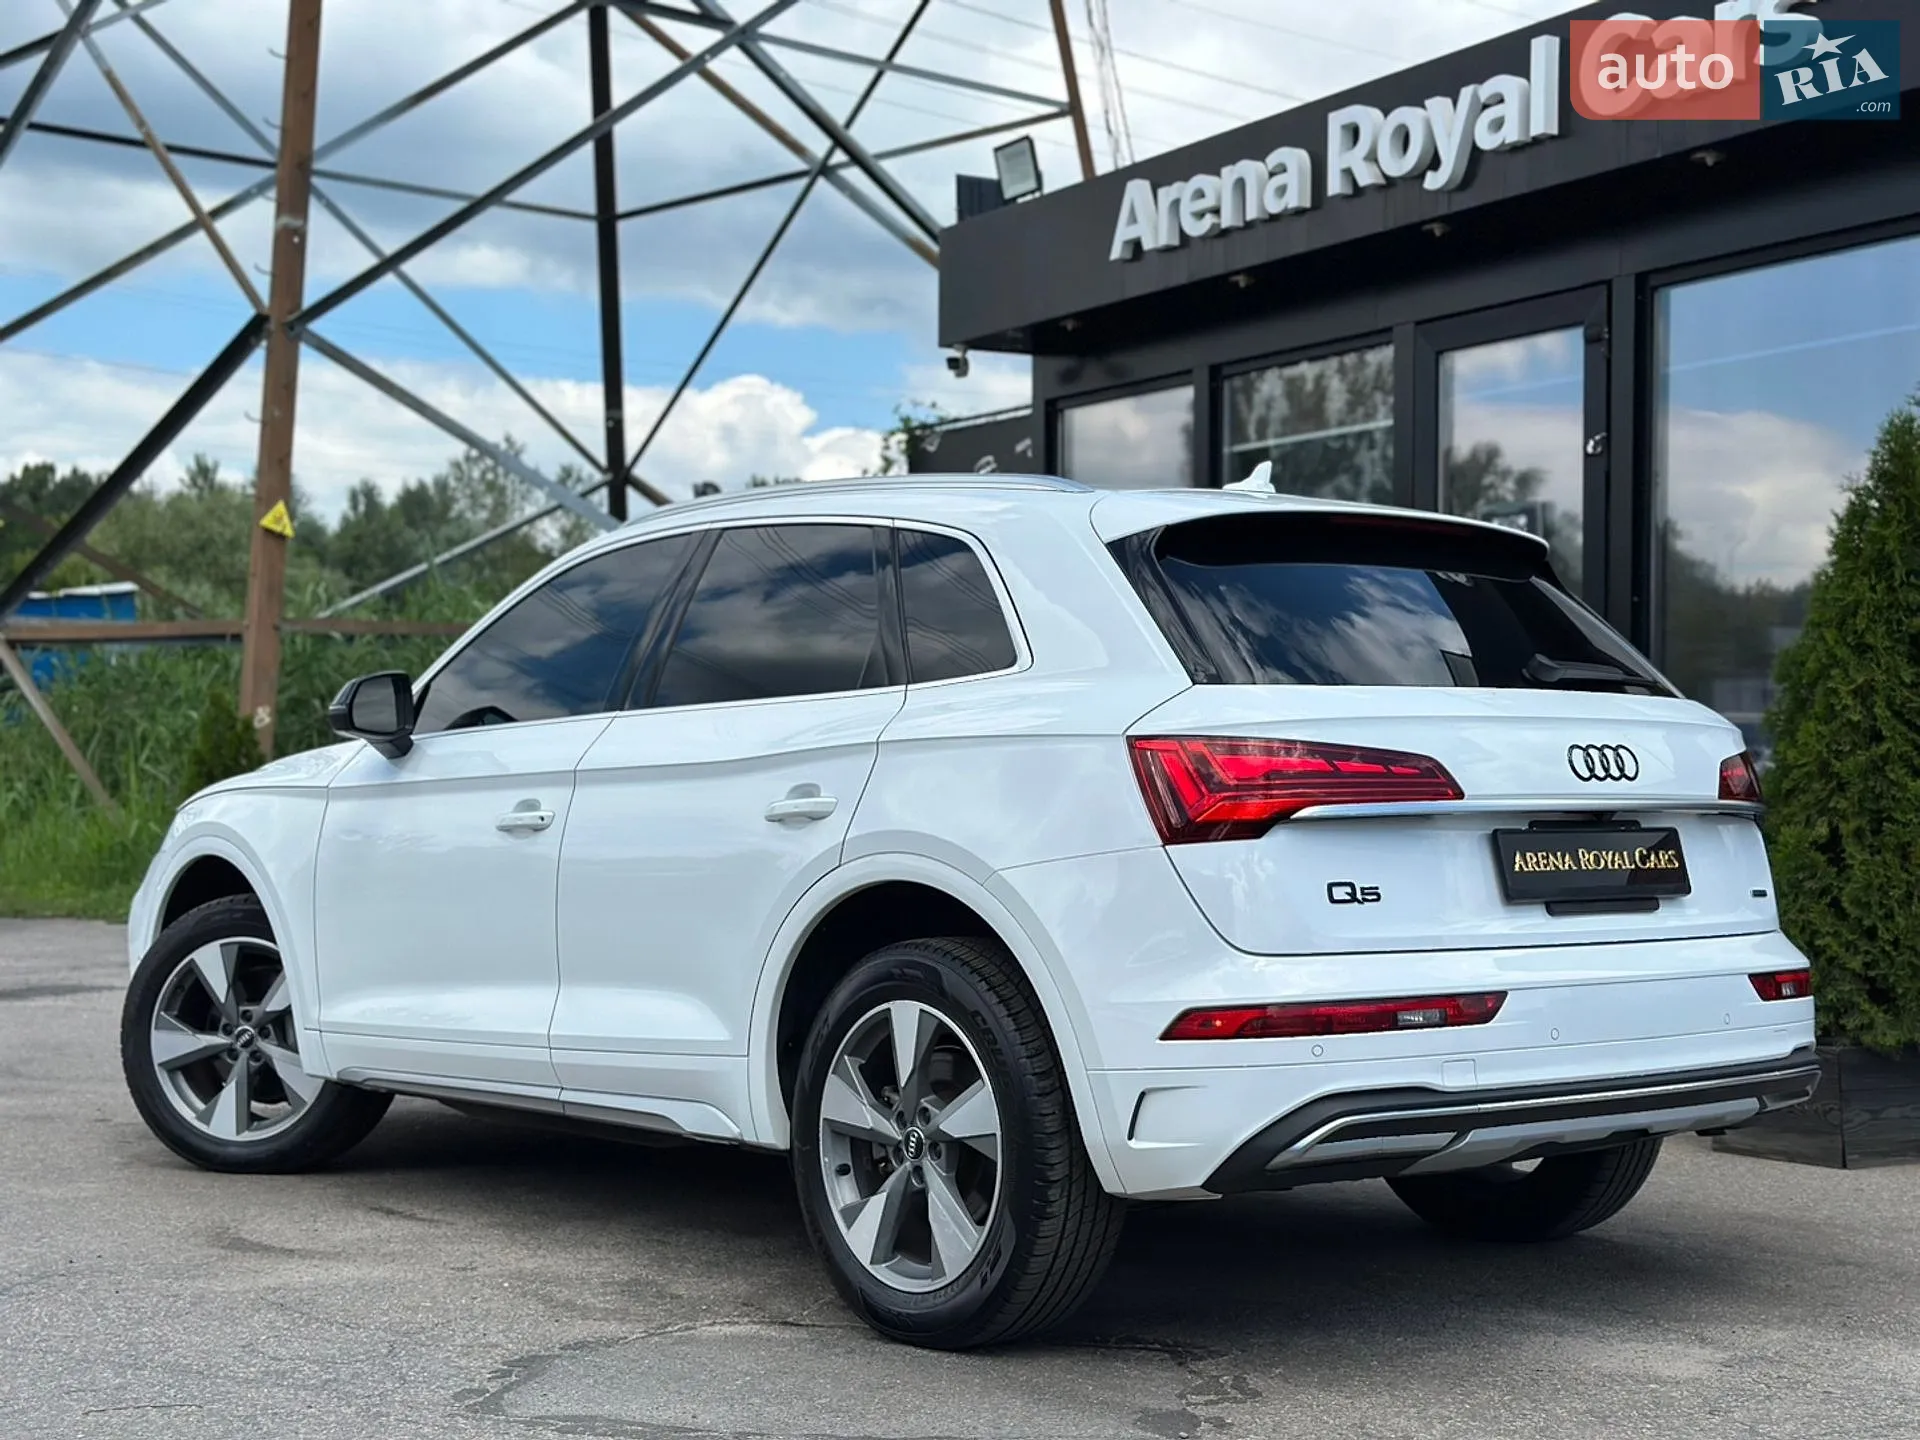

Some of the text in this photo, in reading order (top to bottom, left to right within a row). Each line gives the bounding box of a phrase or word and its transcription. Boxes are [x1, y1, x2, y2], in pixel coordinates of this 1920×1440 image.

[1109, 146, 1312, 261] Arena
[1327, 34, 1561, 197] Royal
[1514, 850, 1577, 872] ARENA
[1326, 881, 1382, 905] Q5
